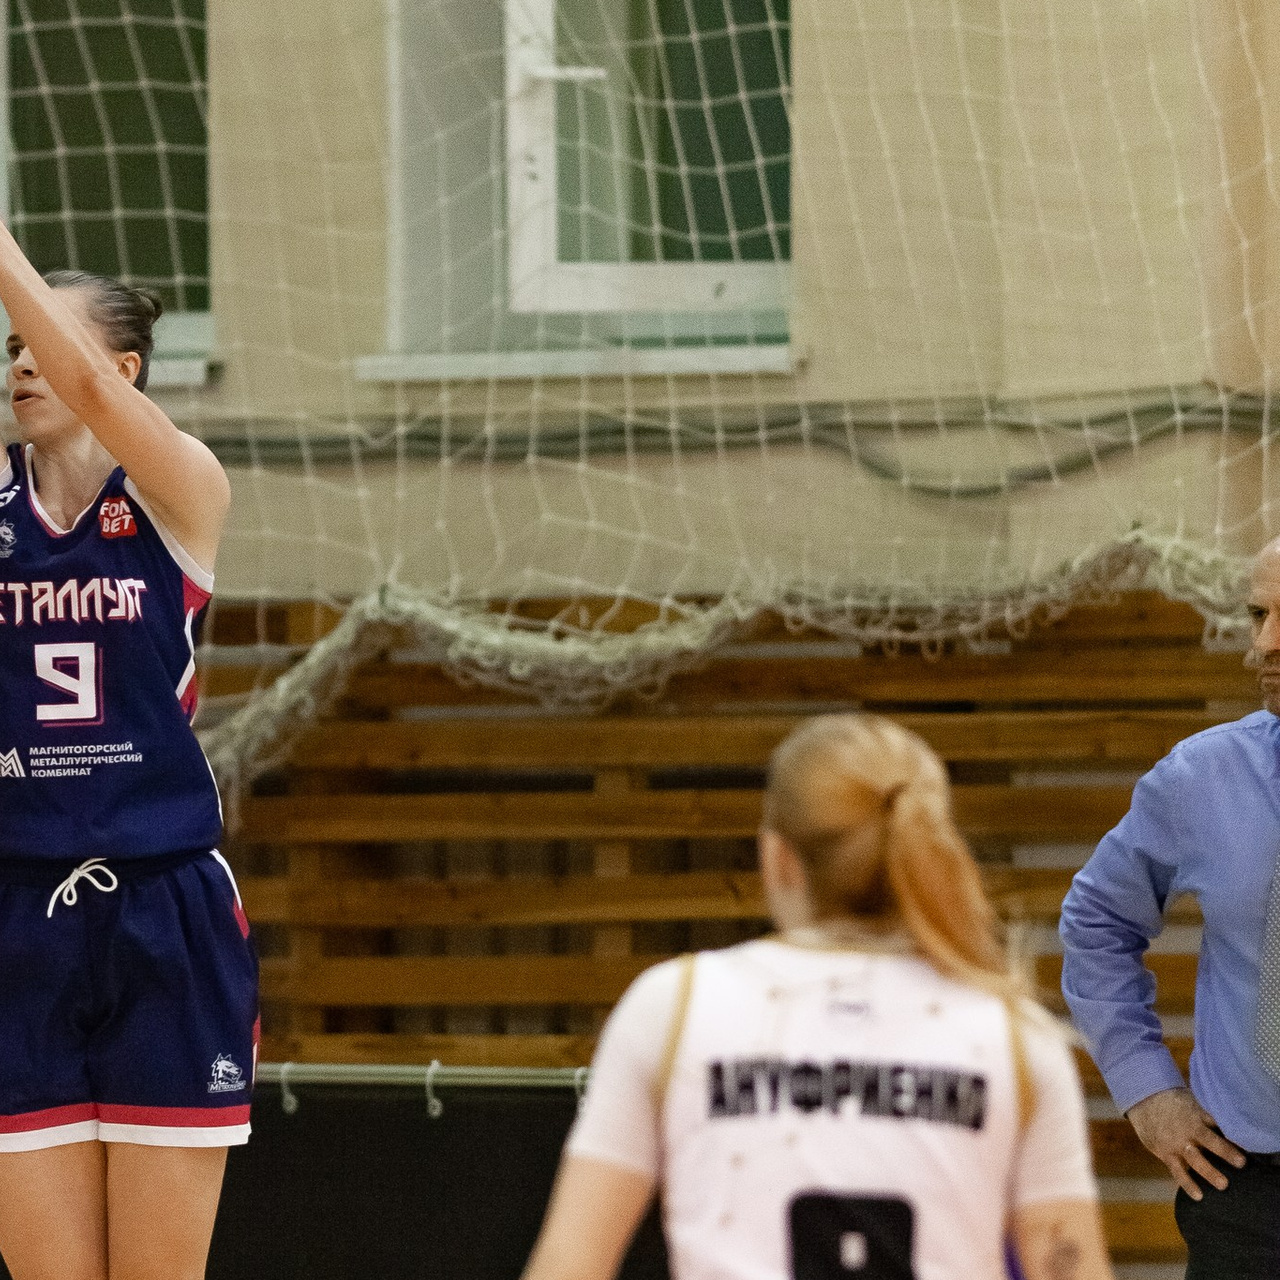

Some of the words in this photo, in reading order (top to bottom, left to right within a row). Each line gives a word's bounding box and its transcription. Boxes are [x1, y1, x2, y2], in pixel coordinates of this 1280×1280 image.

[102, 514, 133, 533] BET
[34, 642, 100, 724] 9
[28, 741, 133, 756] МАГНИТОГОРСКИЙ
[30, 752, 143, 767] МЕТАЛЛУРГИЧЕСКИЙ
[31, 767, 92, 778] КОМБИНАТ
